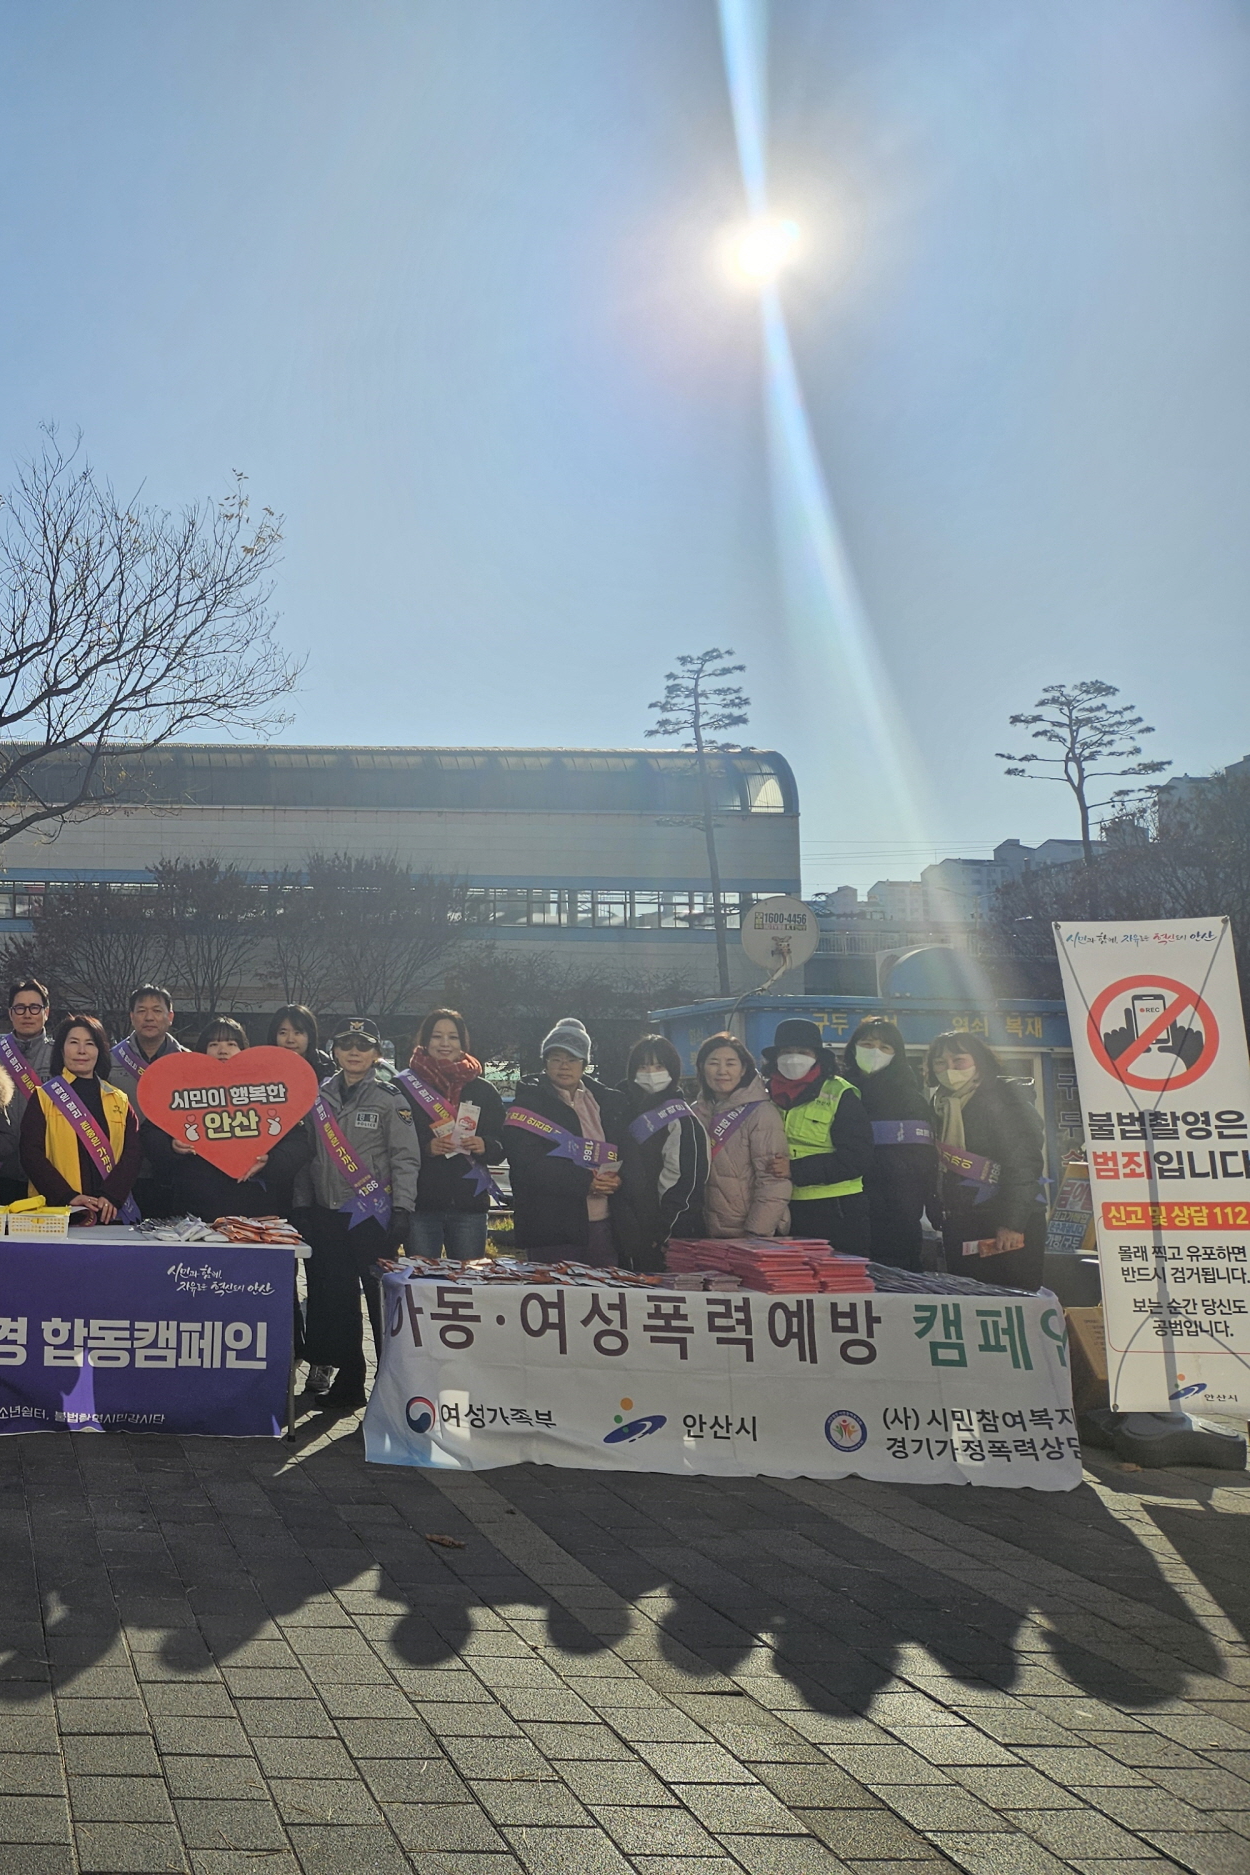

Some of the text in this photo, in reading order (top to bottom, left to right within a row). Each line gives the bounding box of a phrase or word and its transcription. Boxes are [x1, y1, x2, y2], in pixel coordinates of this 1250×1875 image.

[764, 912, 807, 924] 1600-4456
[1065, 931, 1095, 948] 시민과
[1189, 930, 1218, 942] 안산
[171, 1084, 286, 1109] 시민이 행복한
[66, 1101, 87, 1120] 멀리,
[80, 1120, 101, 1148] 존중은
[204, 1110, 260, 1139] 안산
[1088, 1110, 1248, 1141] 불법촬영은
[336, 1147, 358, 1173] 가까이
[1092, 1150, 1250, 1180] 범죄입니다
[358, 1180, 379, 1197] 1366
[1108, 1205, 1249, 1226] 신고 및 상담 112
[1118, 1245, 1247, 1263] 몰래 찍고 유포하면
[167, 1262, 199, 1282] 시민과
[1121, 1267, 1250, 1284] 반드시 검거됩니다.
[211, 1281, 245, 1297] 혁신도시
[248, 1282, 276, 1296] 안산
[1132, 1298, 1249, 1316] 보는 순간 당신도
[1152, 1319, 1235, 1338] 공범입니다.
[41, 1317, 268, 1370] 합동캠페인
[1204, 1394, 1238, 1402] 안산시
[440, 1403, 557, 1430] 여성가족부
[883, 1407, 920, 1430] (사)
[682, 1414, 758, 1442] 안산시
